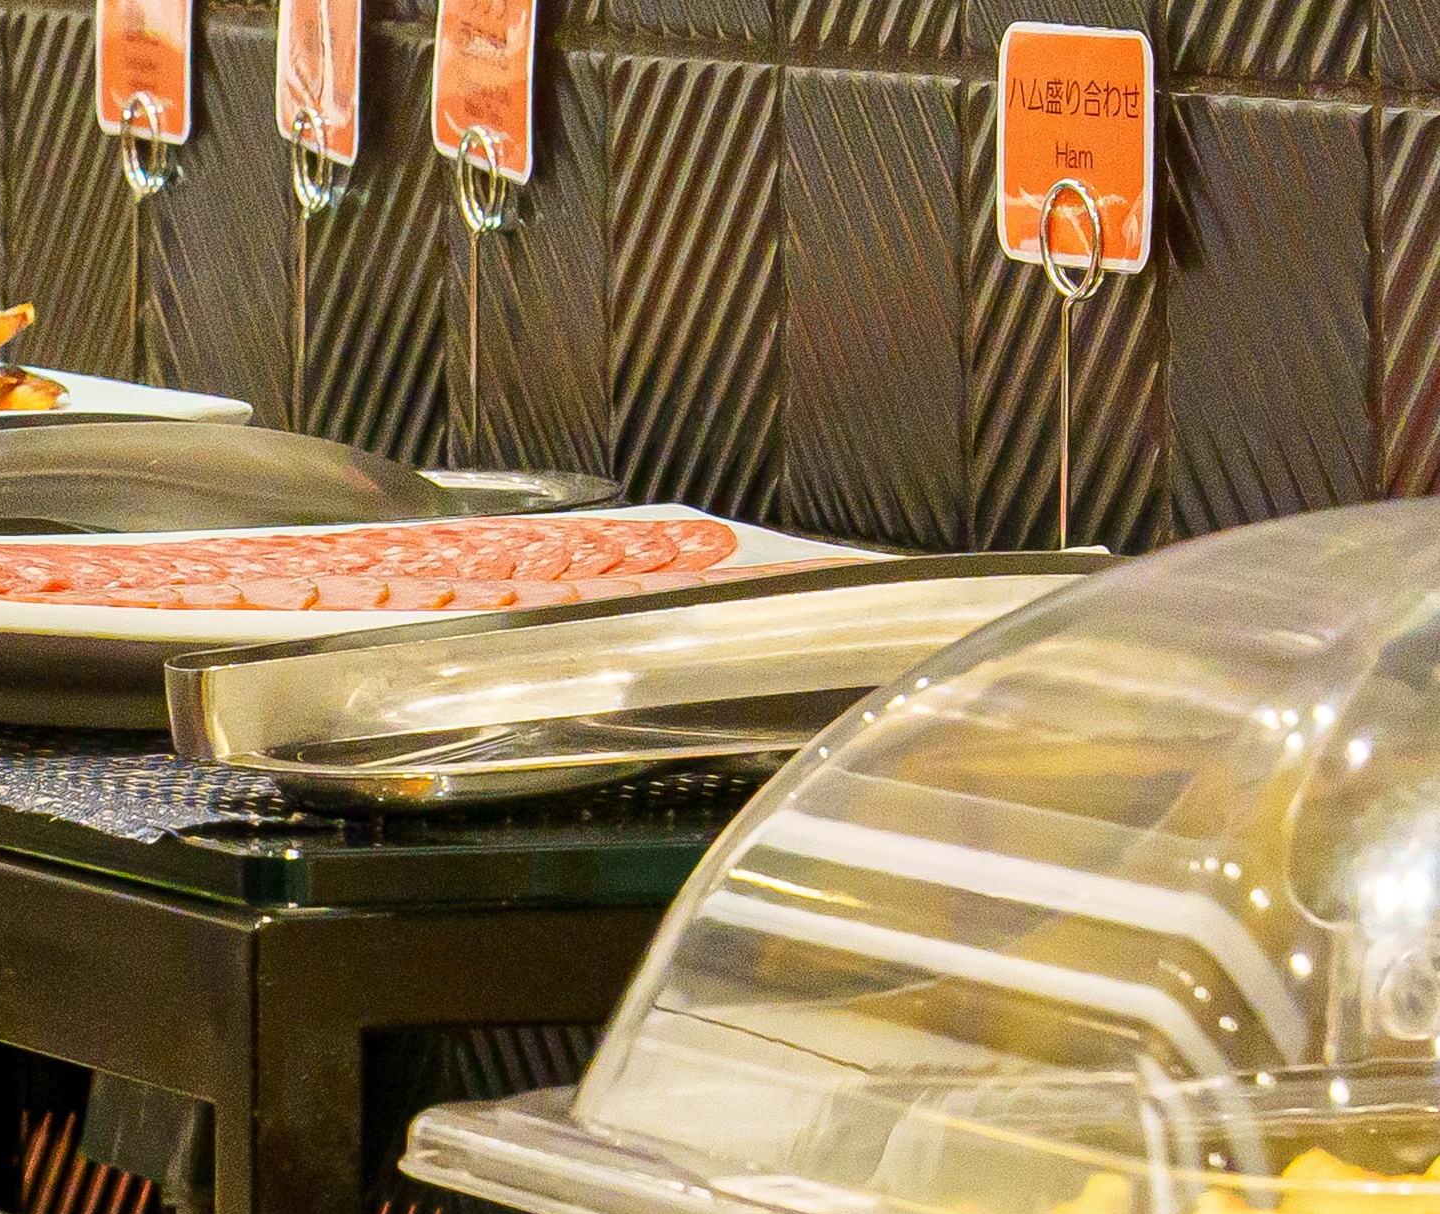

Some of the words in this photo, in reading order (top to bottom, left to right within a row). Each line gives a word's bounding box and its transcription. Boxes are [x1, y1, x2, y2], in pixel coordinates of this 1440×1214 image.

[1009, 78, 1140, 118] ハム盛り合わせ
[1055, 141, 1093, 169] Ham
